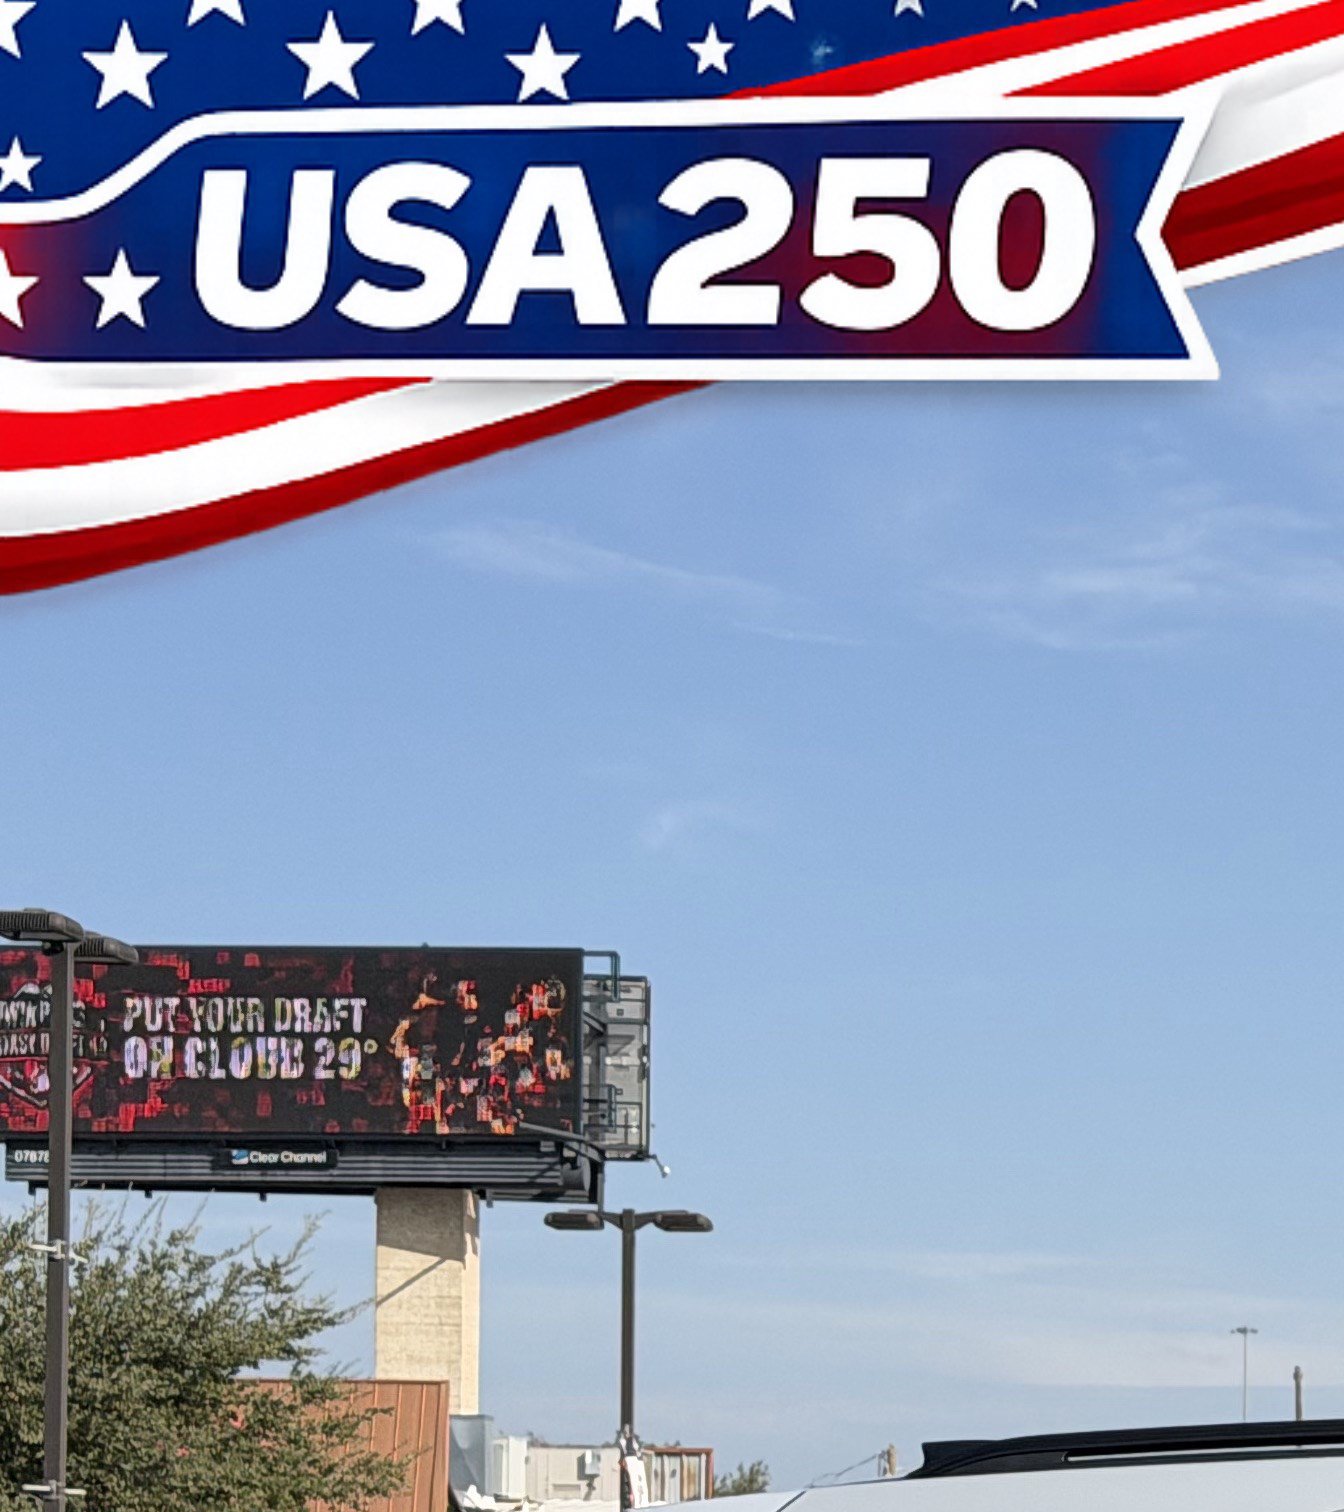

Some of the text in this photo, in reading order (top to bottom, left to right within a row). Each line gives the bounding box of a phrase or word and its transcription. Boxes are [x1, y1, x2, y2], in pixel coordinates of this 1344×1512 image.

[123, 996, 181, 1033] PUT
[186, 996, 265, 1034] YOUR
[274, 996, 368, 1034] DRAFT
[184, 1036, 305, 1080] CLOUD
[249, 1151, 327, 1164] Clear Channel
